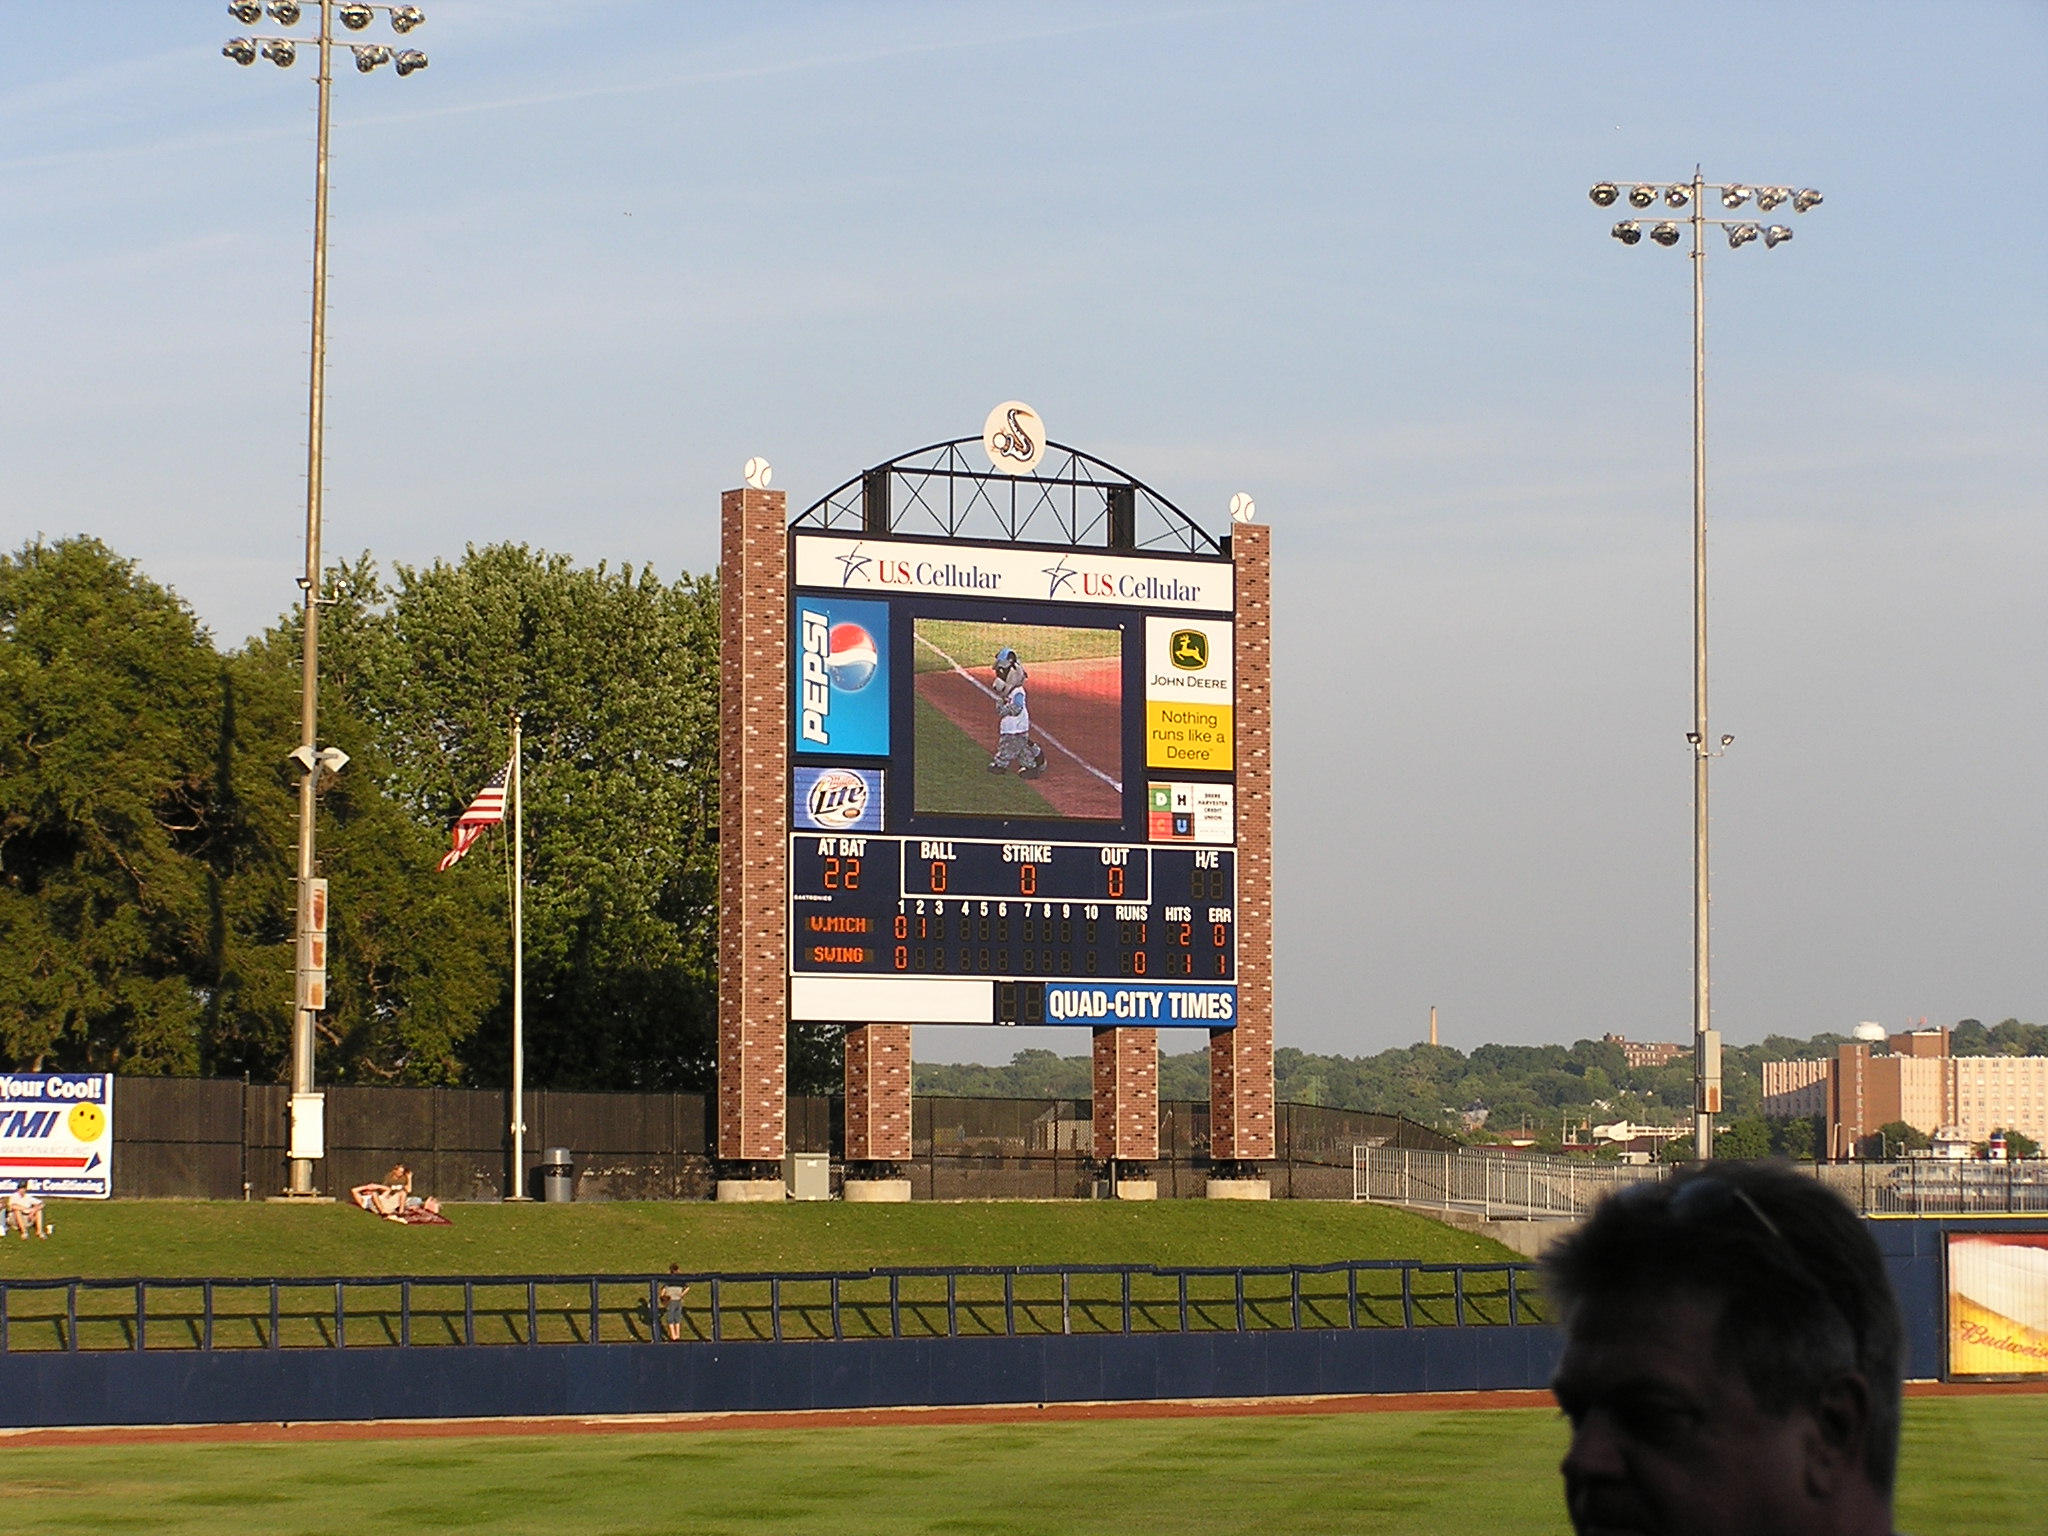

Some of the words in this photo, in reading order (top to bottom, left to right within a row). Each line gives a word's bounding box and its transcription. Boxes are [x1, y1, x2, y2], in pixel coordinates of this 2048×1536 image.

[879, 559, 912, 585] U.S.
[916, 562, 1002, 590] Cellular
[1082, 573, 1116, 596] U.S.
[1119, 575, 1202, 603] Cellular
[802, 609, 829, 745] PEPSI
[1151, 675, 1184, 687] JOHN
[1187, 676, 1227, 689] DEERE
[1162, 710, 1217, 728] Nothing
[1153, 729, 1184, 740] runs
[1188, 729, 1211, 743] like
[1216, 732, 1225, 743] a
[1167, 746, 1210, 760] Deere
[814, 786, 864, 815] Lite
[818, 838, 836, 855] AT
[840, 839, 867, 857] BAT
[920, 841, 956, 860] BALL
[1002, 845, 1052, 863] STRIKE
[1101, 848, 1129, 865] OUT
[1195, 850, 1219, 869] H/E
[824, 857, 860, 888] 22
[931, 861, 947, 892] 0
[1020, 864, 1036, 894] 0
[1108, 867, 1123, 897] 0
[898, 900, 905, 914] 1
[916, 900, 925, 915] 2
[935, 900, 943, 915] 3
[961, 901, 969, 916] 4
[980, 902, 988, 916] 5
[999, 902, 1007, 917] 6
[1024, 903, 1031, 917] 7
[1043, 903, 1051, 918] 8
[1062, 904, 1070, 918] 9
[1084, 905, 1098, 920] 10
[1116, 905, 1148, 921] RUNS
[1165, 906, 1192, 922] HITS
[1209, 908, 1231, 923] ERR
[894, 915, 907, 939] 0
[1180, 924, 1191, 945] 2
[1214, 924, 1225, 946] 0
[814, 947, 863, 962] SWING
[895, 946, 908, 969] 0
[1134, 951, 1146, 974] 0
[1050, 990, 1163, 1020] QUAD-CITY
[1168, 991, 1233, 1020] TIMES
[0, 1076, 45, 1100] Your
[46, 1077, 102, 1099] Cool!
